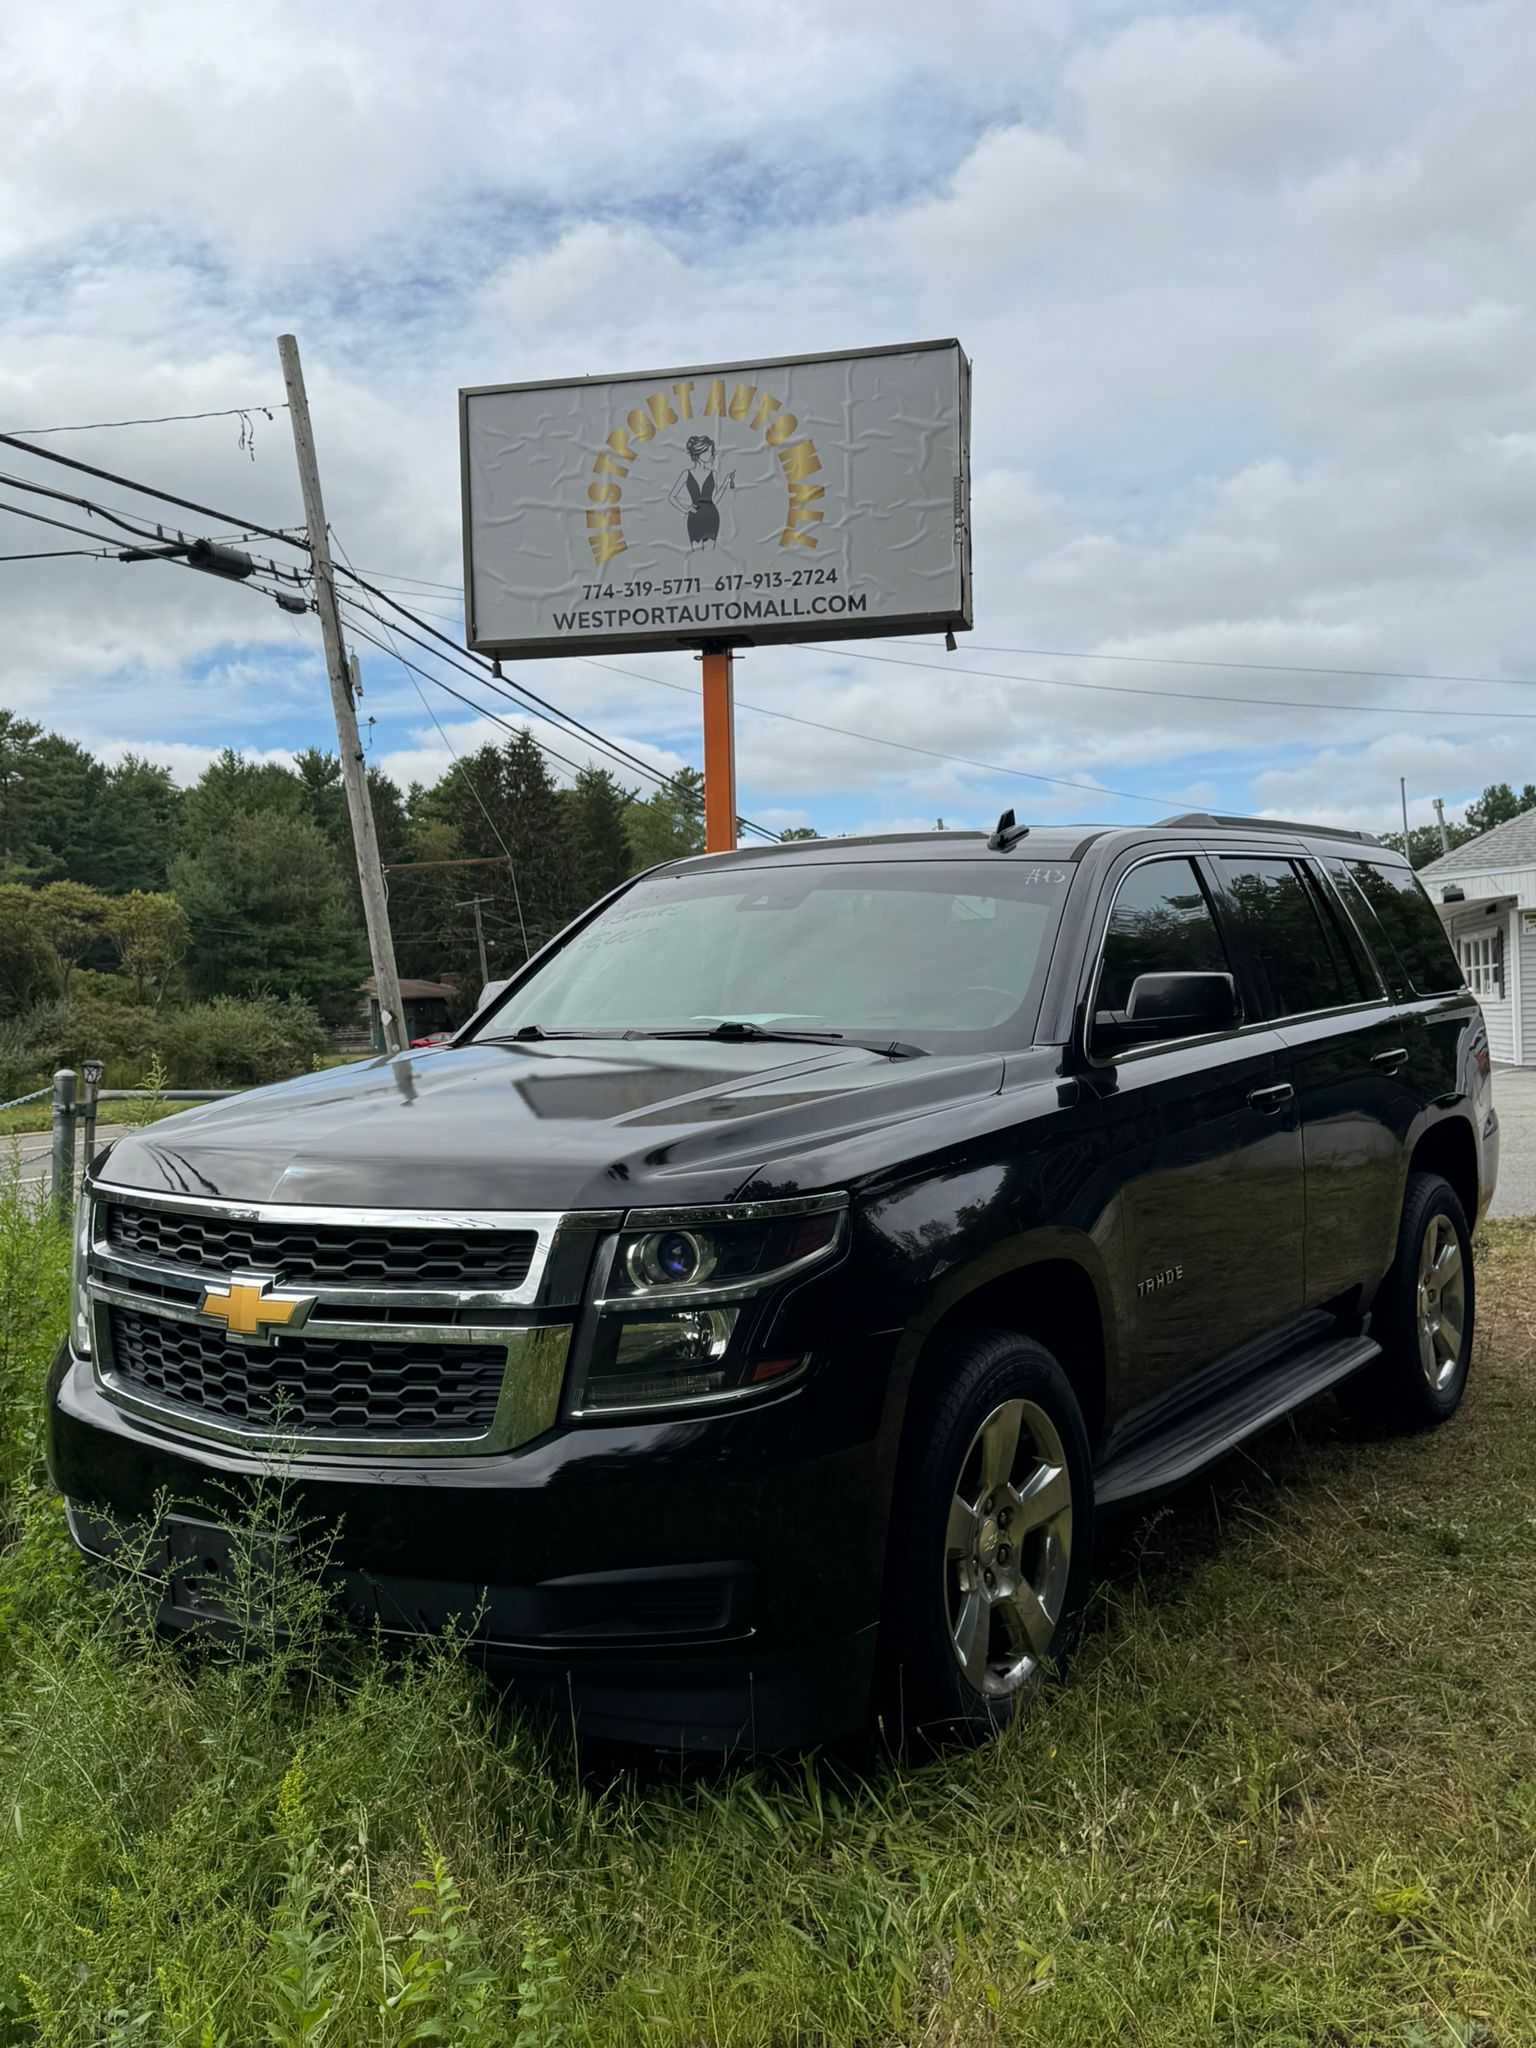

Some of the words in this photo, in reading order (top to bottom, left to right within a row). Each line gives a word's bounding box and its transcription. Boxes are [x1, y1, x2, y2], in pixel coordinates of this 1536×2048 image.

[586, 381, 695, 564] WESTPORT
[704, 379, 798, 446] AUTO
[778, 439, 823, 549] MALL
[582, 577, 701, 600] 774-319-5771
[714, 568, 838, 591] 617-913-2724
[553, 593, 867, 630] WESTPORTAUTOMALL.COM
[1137, 1264, 1183, 1297] TAHOE
